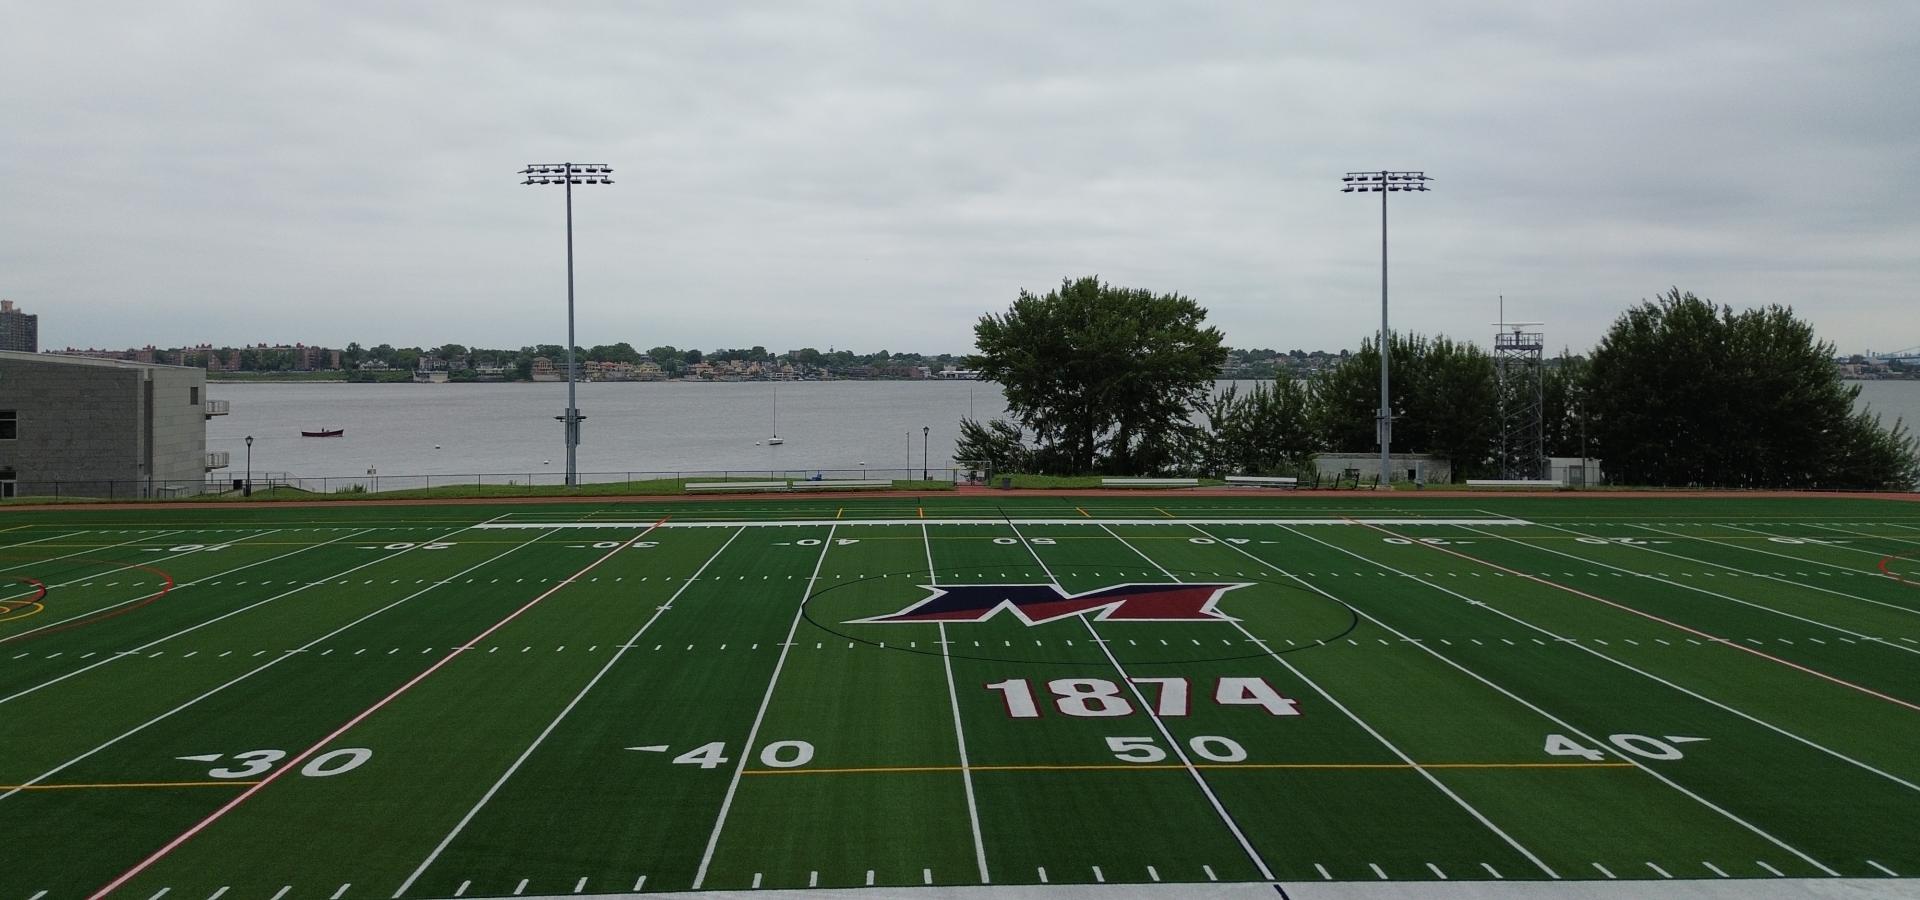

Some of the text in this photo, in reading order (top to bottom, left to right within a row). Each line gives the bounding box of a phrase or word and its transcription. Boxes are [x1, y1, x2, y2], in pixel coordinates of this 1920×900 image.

[796, 538, 860, 546] 40
[1188, 537, 1250, 545] 40
[840, 583, 1259, 626] M
[985, 677, 1301, 718] 1874
[672, 740, 815, 769] 40
[1105, 735, 1248, 763] 50
[1543, 733, 1684, 761] 40
[208, 748, 373, 778] 30
